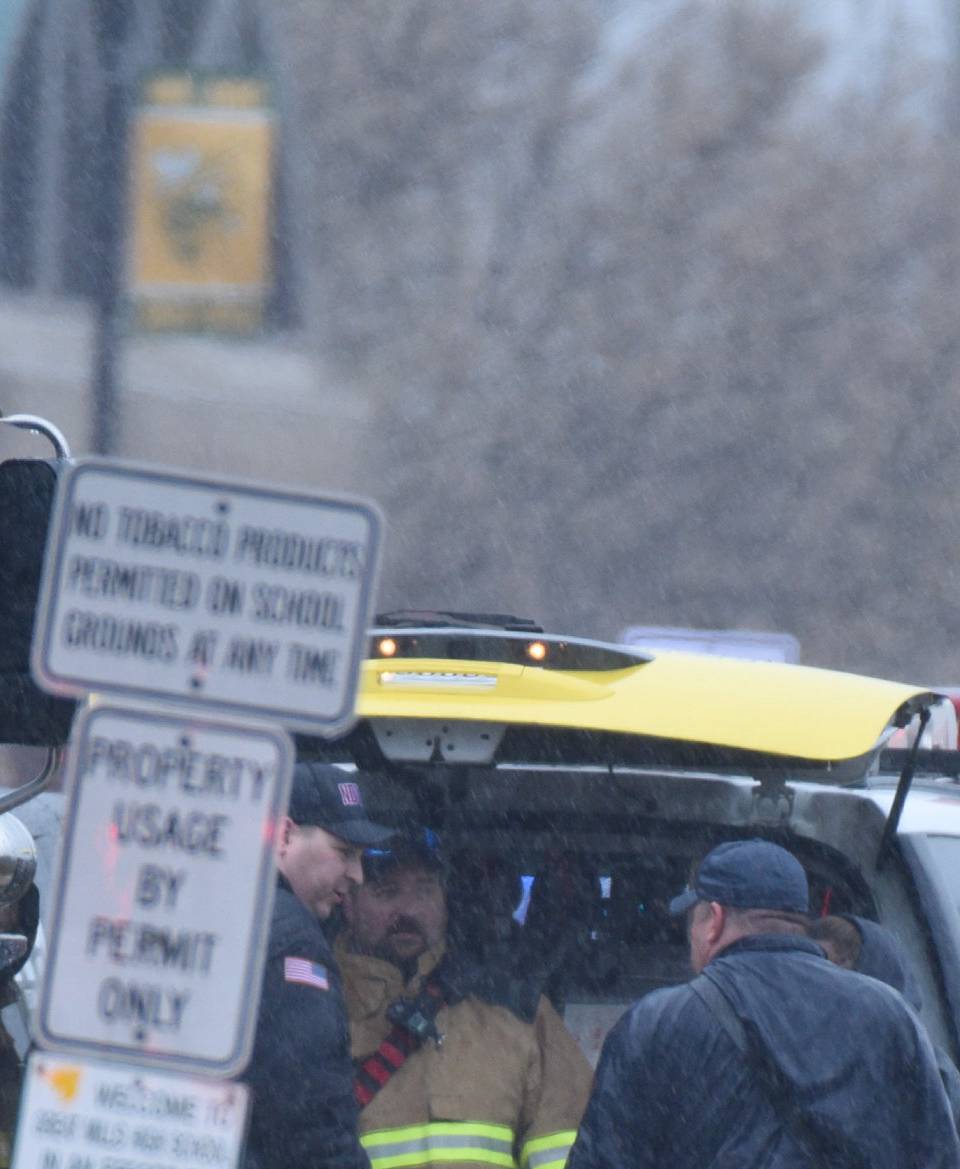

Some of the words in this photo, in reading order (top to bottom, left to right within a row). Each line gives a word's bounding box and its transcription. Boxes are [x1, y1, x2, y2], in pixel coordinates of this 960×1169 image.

[75, 501, 109, 541] NO
[116, 506, 231, 561] TOBACCO
[235, 522, 364, 579] PRODUCTS
[67, 555, 201, 612] PERMITTED
[205, 573, 245, 616] ON
[250, 580, 346, 632] SCHOOL
[62, 607, 181, 663] GROUNDS
[224, 635, 282, 675] ANY
[290, 642, 338, 687] TIME
[89, 735, 273, 801] PROPERTY
[112, 801, 229, 860] USAGE
[135, 863, 186, 907] BY
[87, 917, 220, 977] PERMIT
[96, 976, 189, 1030] ONLY
